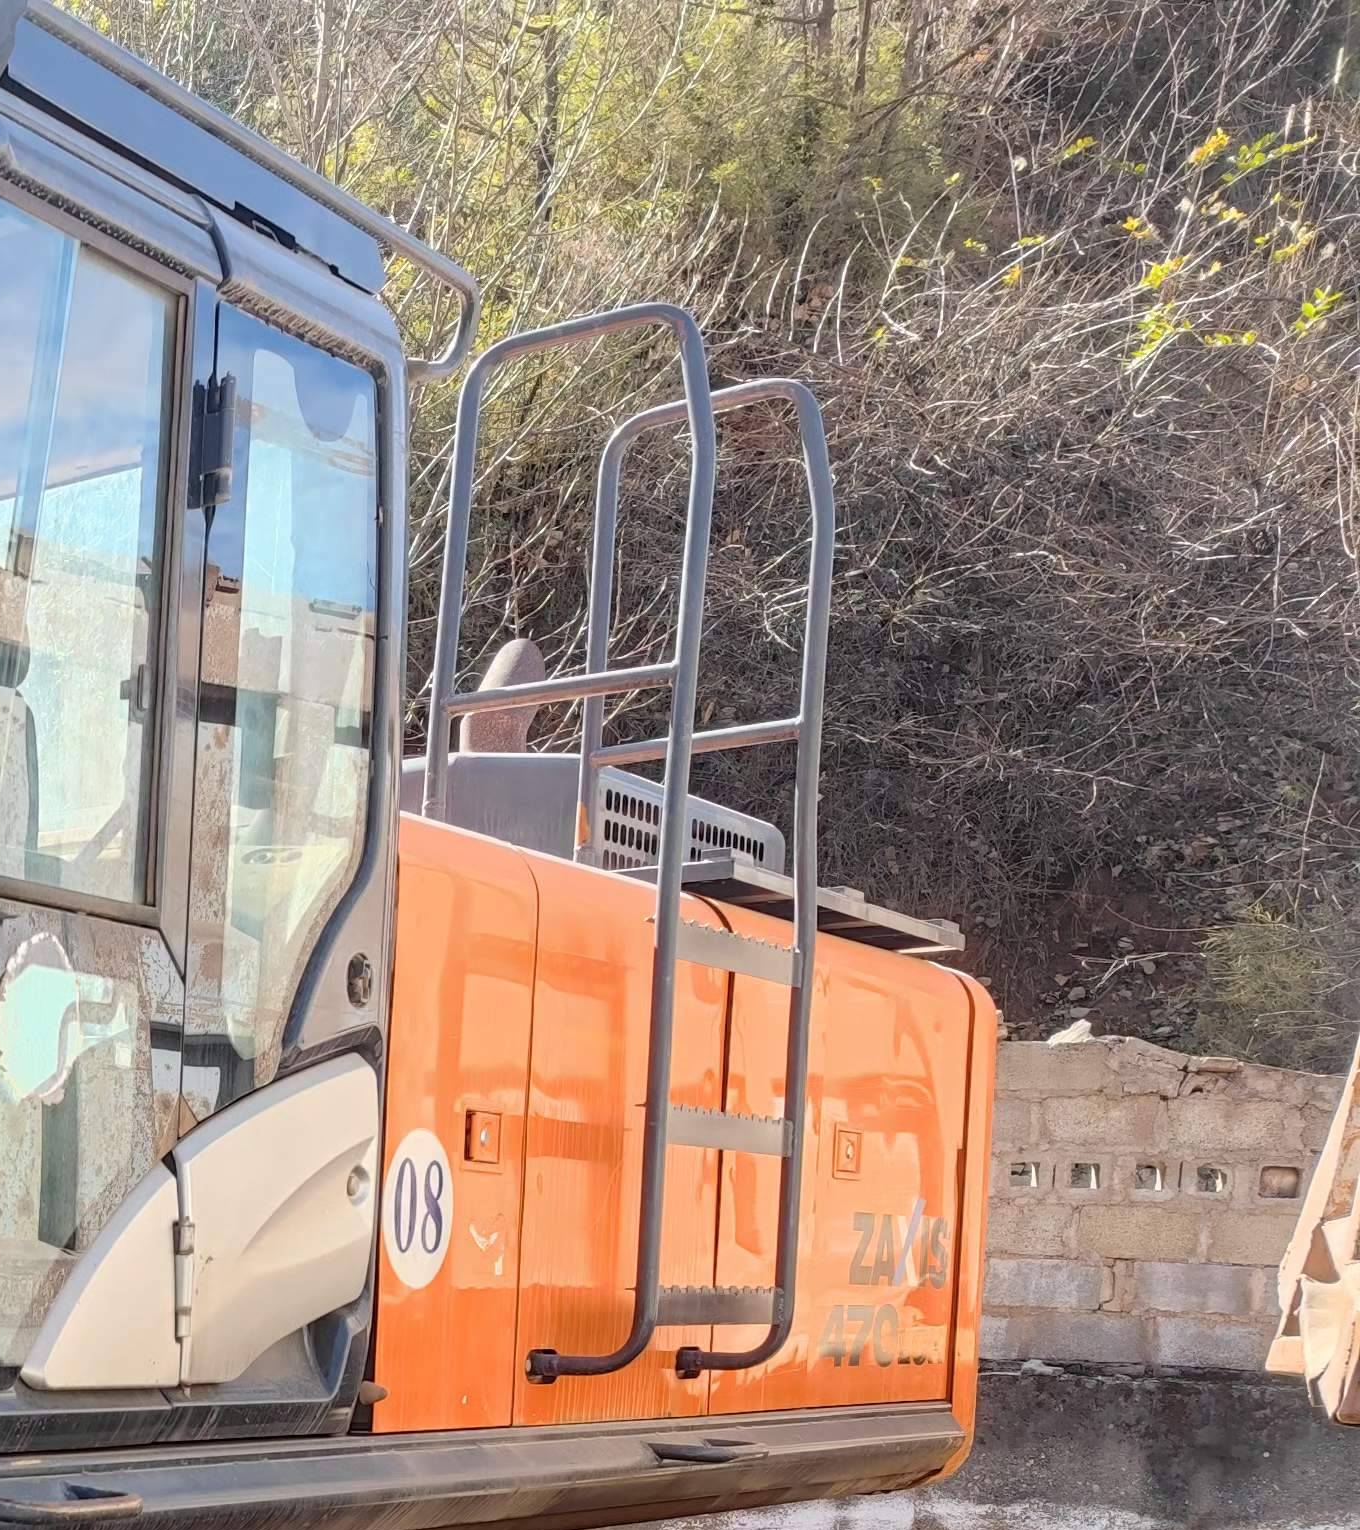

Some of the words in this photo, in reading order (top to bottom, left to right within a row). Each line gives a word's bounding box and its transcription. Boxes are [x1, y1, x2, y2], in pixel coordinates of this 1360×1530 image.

[394, 1157, 443, 1254] 08
[849, 1199, 949, 1289] ZAXIS
[820, 1304, 899, 1367] 470
